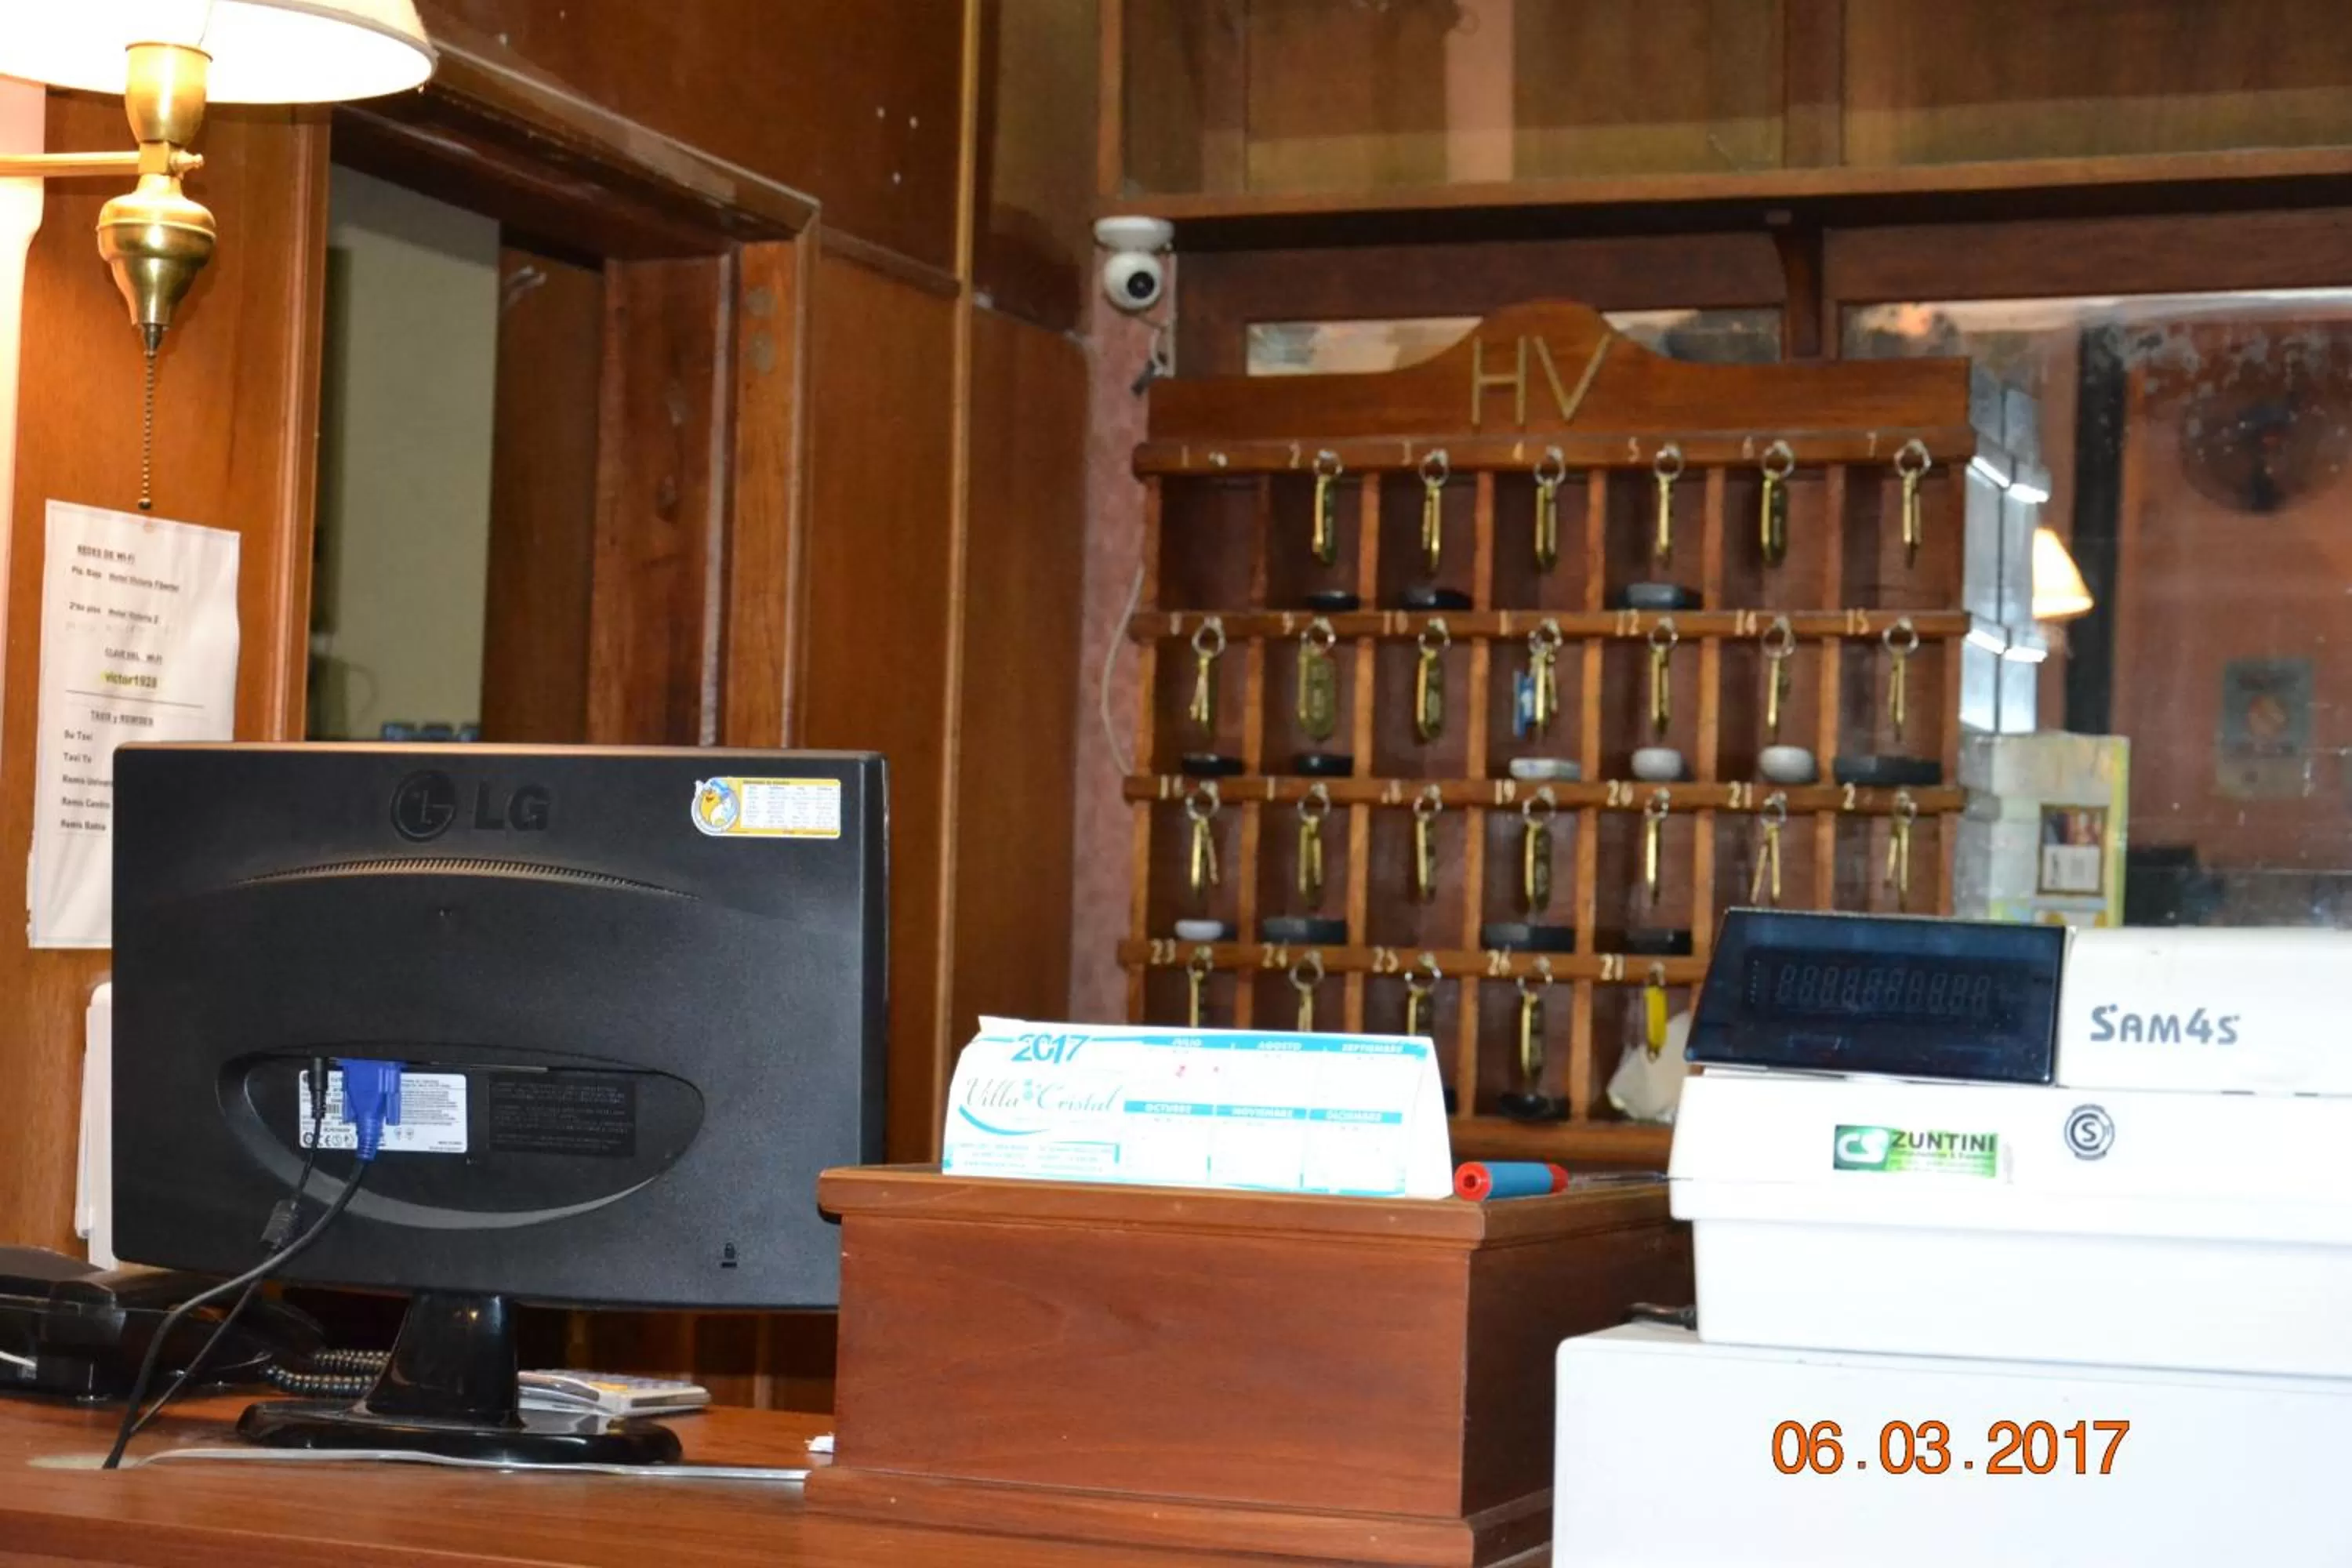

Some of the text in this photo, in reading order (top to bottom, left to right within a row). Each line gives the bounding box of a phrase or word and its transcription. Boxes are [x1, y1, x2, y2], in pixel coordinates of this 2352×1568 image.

[1471, 333, 1613, 425] HV
[474, 779, 552, 832] LG
[1010, 1033, 1091, 1065] 2017
[1890, 1131, 1995, 1152] ZUNTINI
